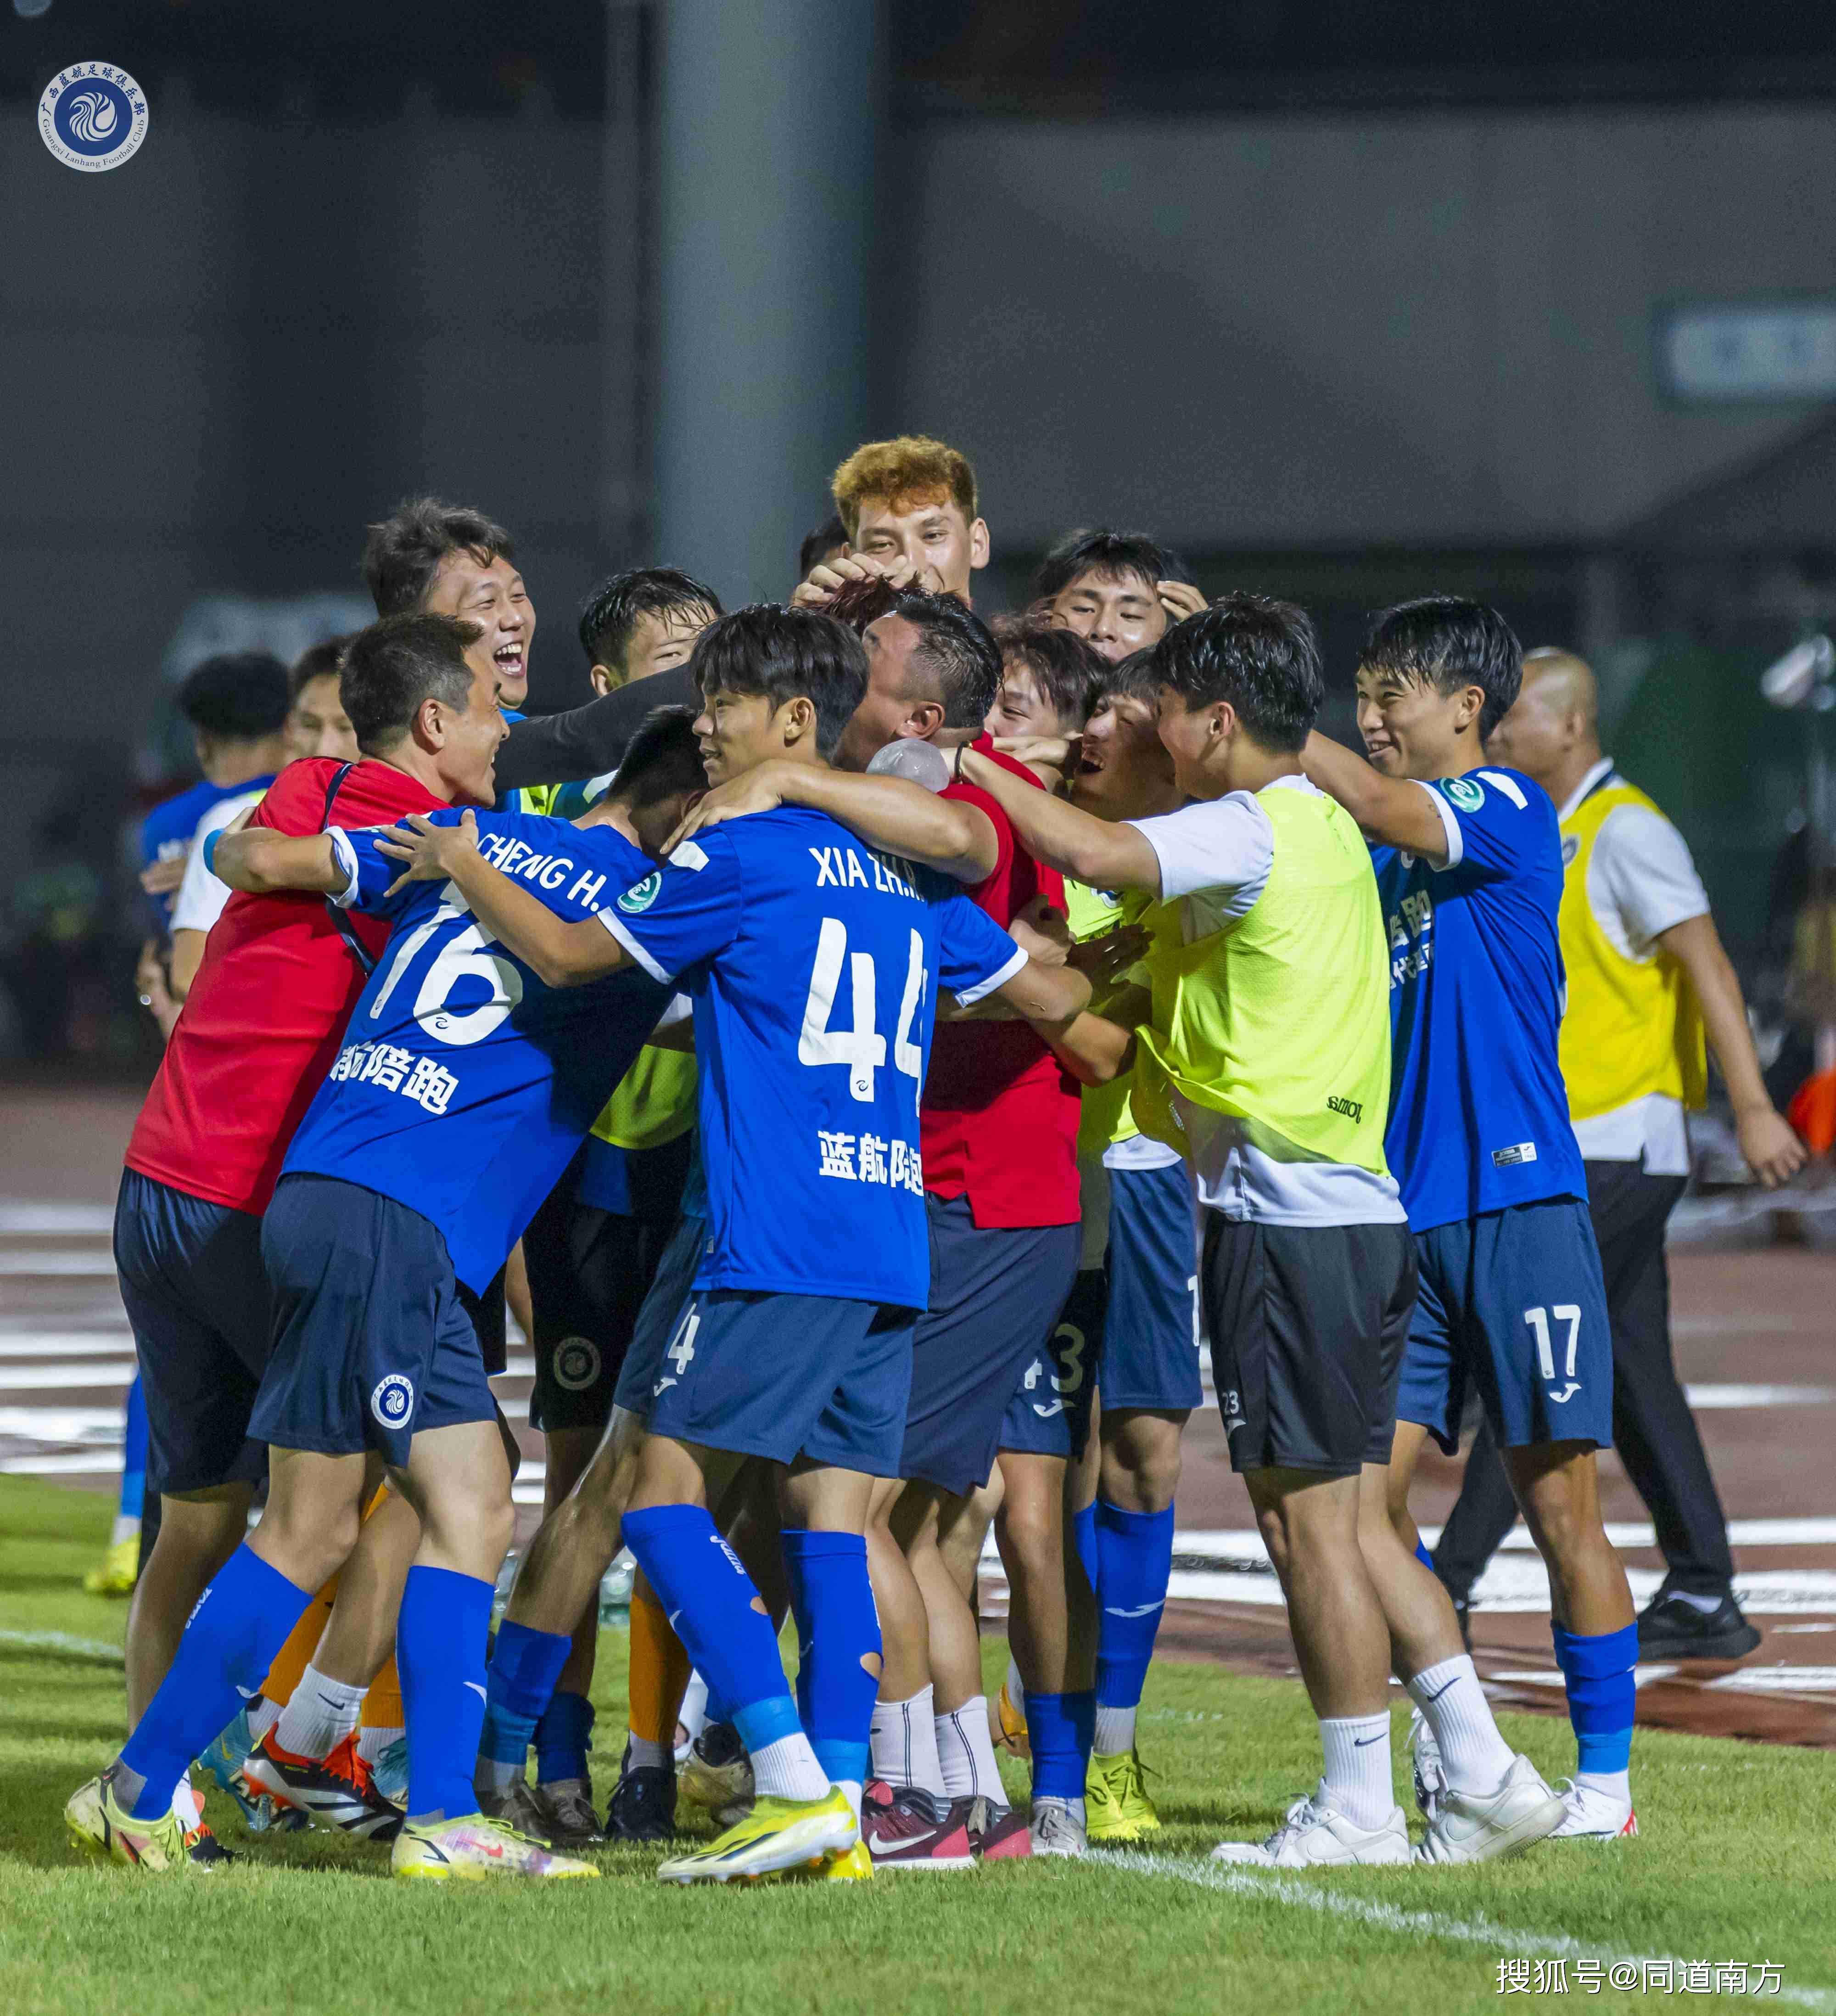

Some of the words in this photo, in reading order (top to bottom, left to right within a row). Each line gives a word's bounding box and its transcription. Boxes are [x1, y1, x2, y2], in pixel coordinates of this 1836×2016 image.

[476, 833, 574, 889] CHENG
[567, 870, 607, 912] H.
[808, 847, 869, 888] XIA
[369, 880, 523, 1045] 16
[798, 917, 928, 1118] 44
[1525, 1305, 1581, 1379] 17
